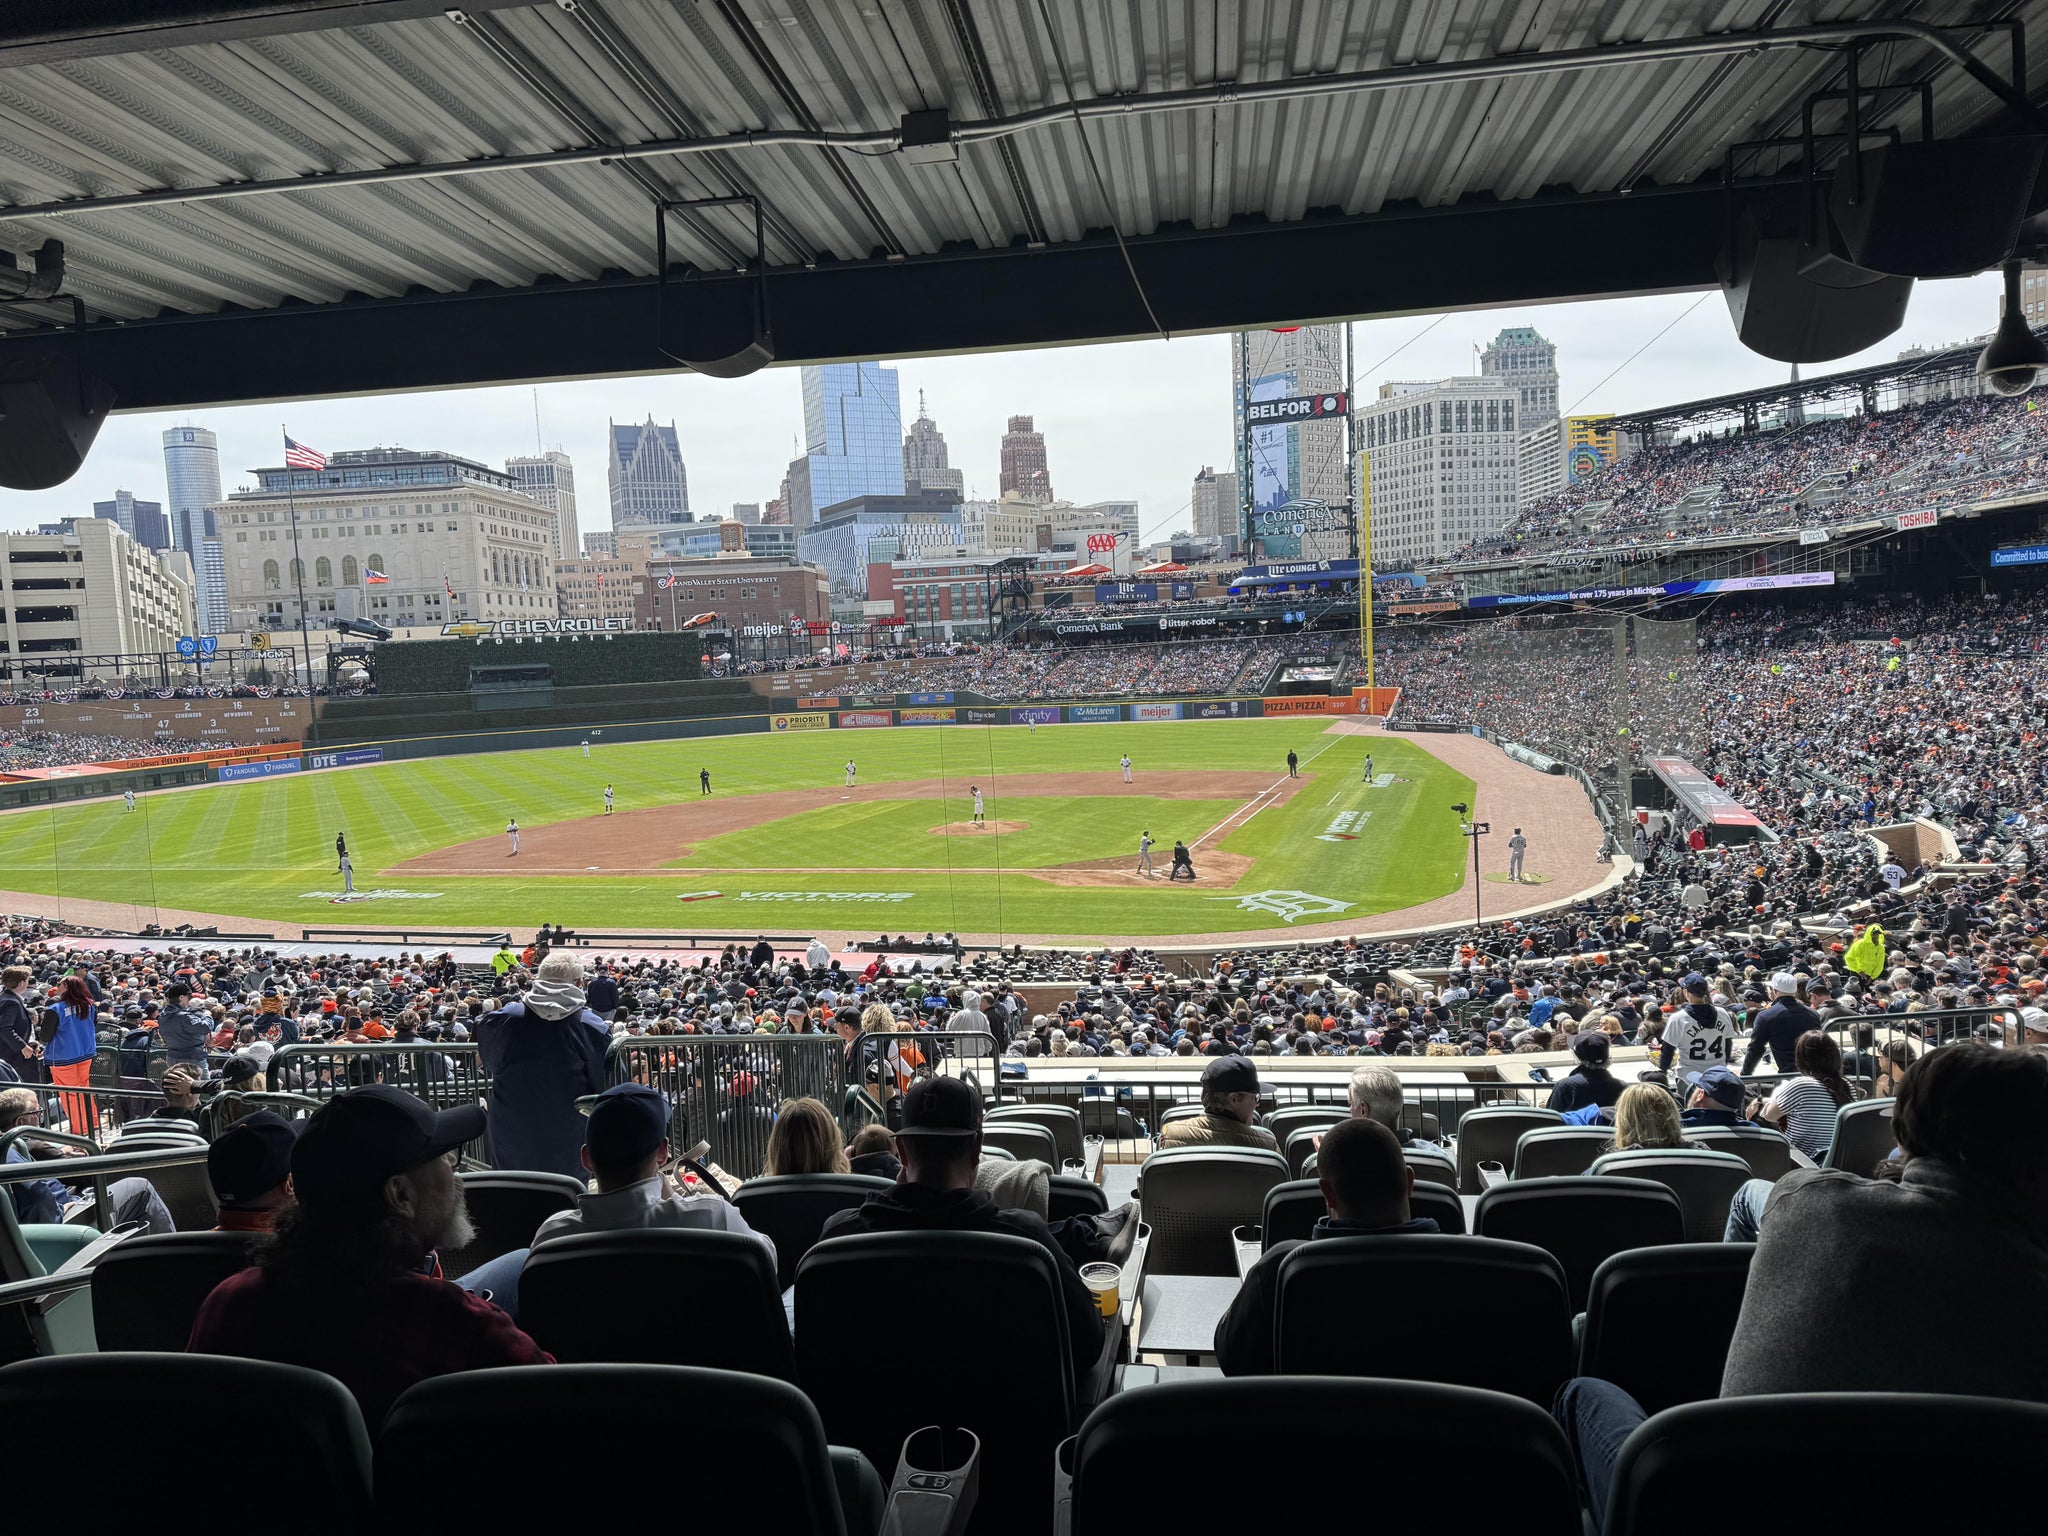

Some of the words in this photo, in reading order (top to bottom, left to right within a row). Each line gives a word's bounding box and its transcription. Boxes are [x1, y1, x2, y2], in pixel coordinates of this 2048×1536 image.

[1249, 400, 1311, 420] BELFOR
[1260, 430, 1273, 443] #1
[1899, 511, 1935, 528] TOSHIBA
[1090, 535, 1115, 551] AAA
[1995, 551, 2028, 563] Committed
[2030, 551, 2036, 560] to
[1286, 563, 1317, 573] LOUNGE
[1119, 583, 1136, 594] Lite
[1498, 595, 1529, 604] Committed
[1537, 593, 1569, 603] businesses
[1594, 590, 1607, 598] 175
[1608, 589, 1625, 599] years
[1634, 586, 1666, 596] Michigan.
[500, 617, 631, 634] CHEVROLET
[743, 622, 783, 638] meijer
[889, 625, 906, 633] LAW
[1101, 621, 1124, 631] Bank
[477, 634, 613, 646] FOUNTAIN
[1298, 656, 1326, 664] PEPSI
[133, 703, 140, 711] 5
[184, 702, 191, 711] 2
[233, 701, 243, 709] 16
[284, 701, 290, 709] 6
[1265, 702, 1294, 712] PIZZA!
[1296, 701, 1325, 711] PIZZA!
[25, 708, 39, 717] 23
[1018, 710, 1051, 723] xfinity
[1141, 705, 1171, 718] meijer
[1201, 709, 1226, 717] Corona
[157, 720, 169, 728] 47
[210, 719, 217, 727] 3
[161, 757, 190, 766] DELIVERY
[313, 755, 337, 768] DTE
[234, 767, 259, 775] FANDUEL
[272, 762, 296, 771] FANDUEL
[1887, 871, 1898, 879] 53
[1687, 1020, 1725, 1038] CABRA
[1689, 1036, 1723, 1060] 24
